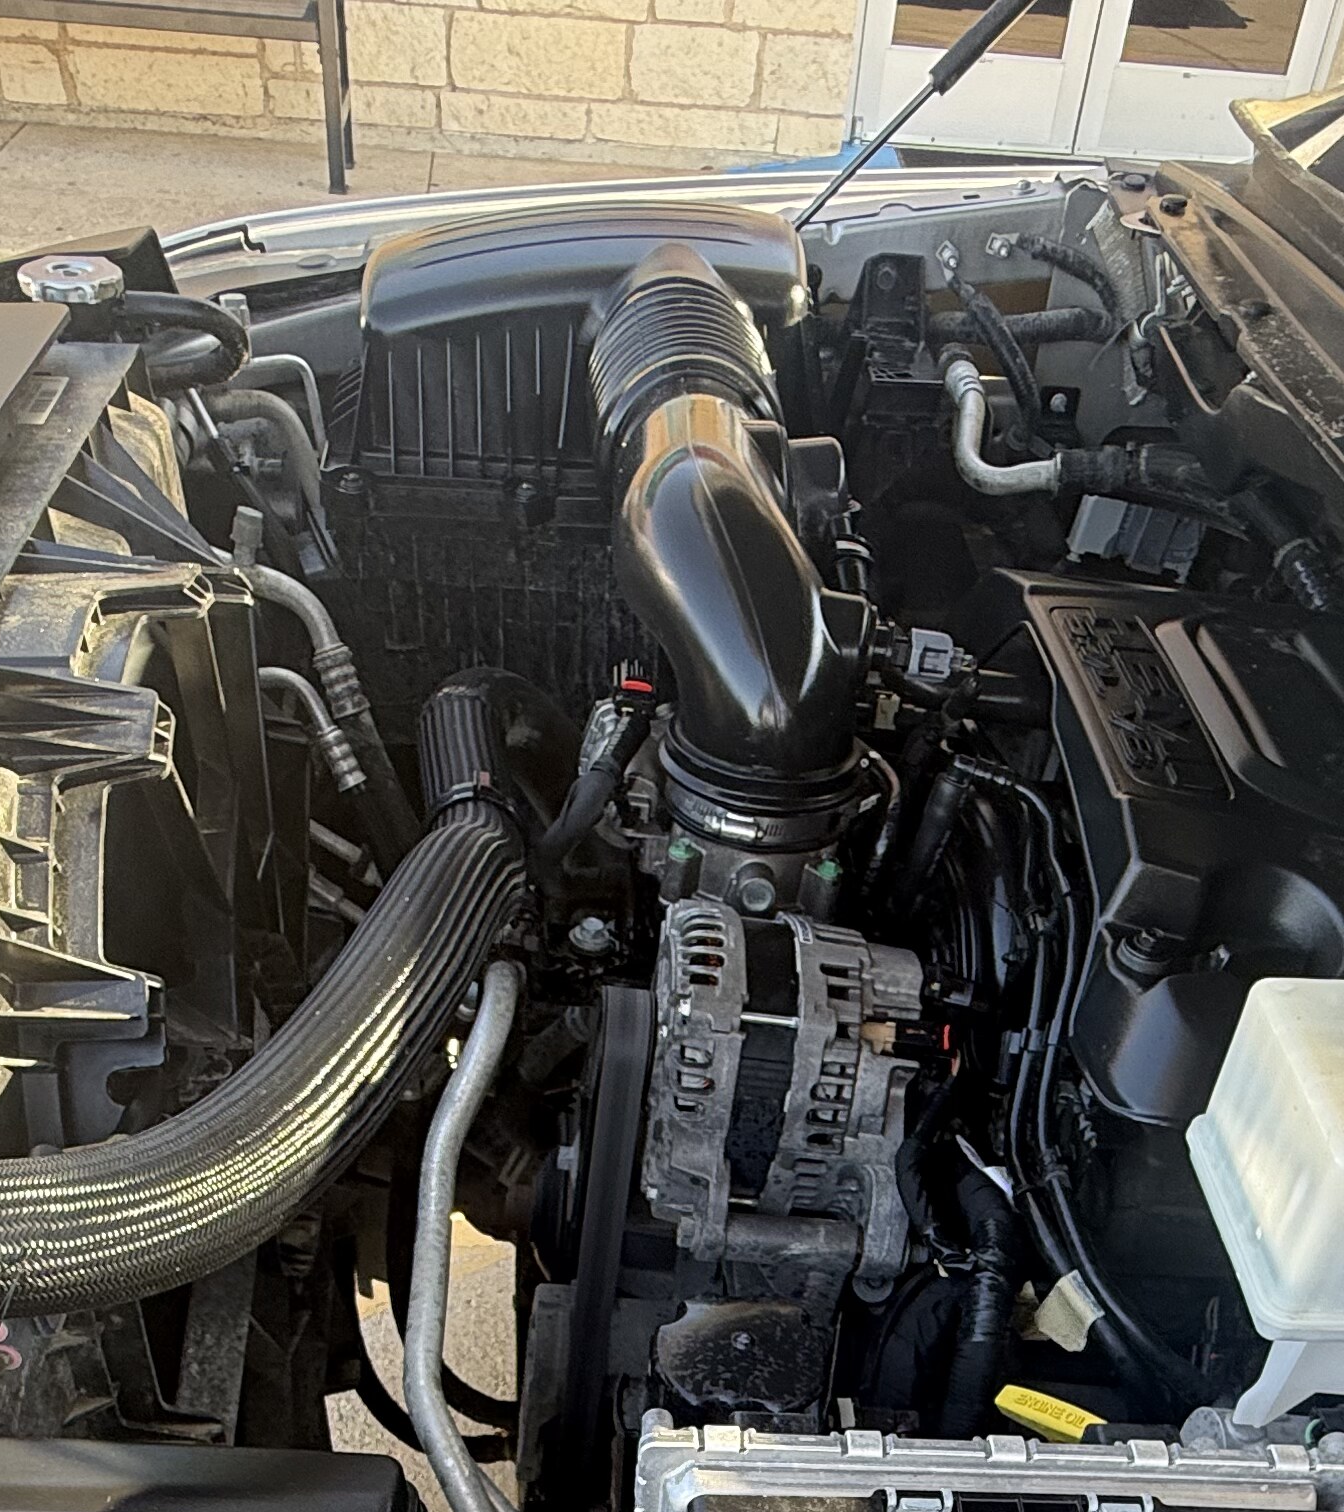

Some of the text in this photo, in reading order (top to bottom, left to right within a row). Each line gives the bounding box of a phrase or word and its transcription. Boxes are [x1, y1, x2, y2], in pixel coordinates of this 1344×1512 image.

[1094, 617, 1214, 787] HEMI
[1108, 709, 1155, 773] V8
[1014, 1394, 1085, 1428] ENGINE OIL
